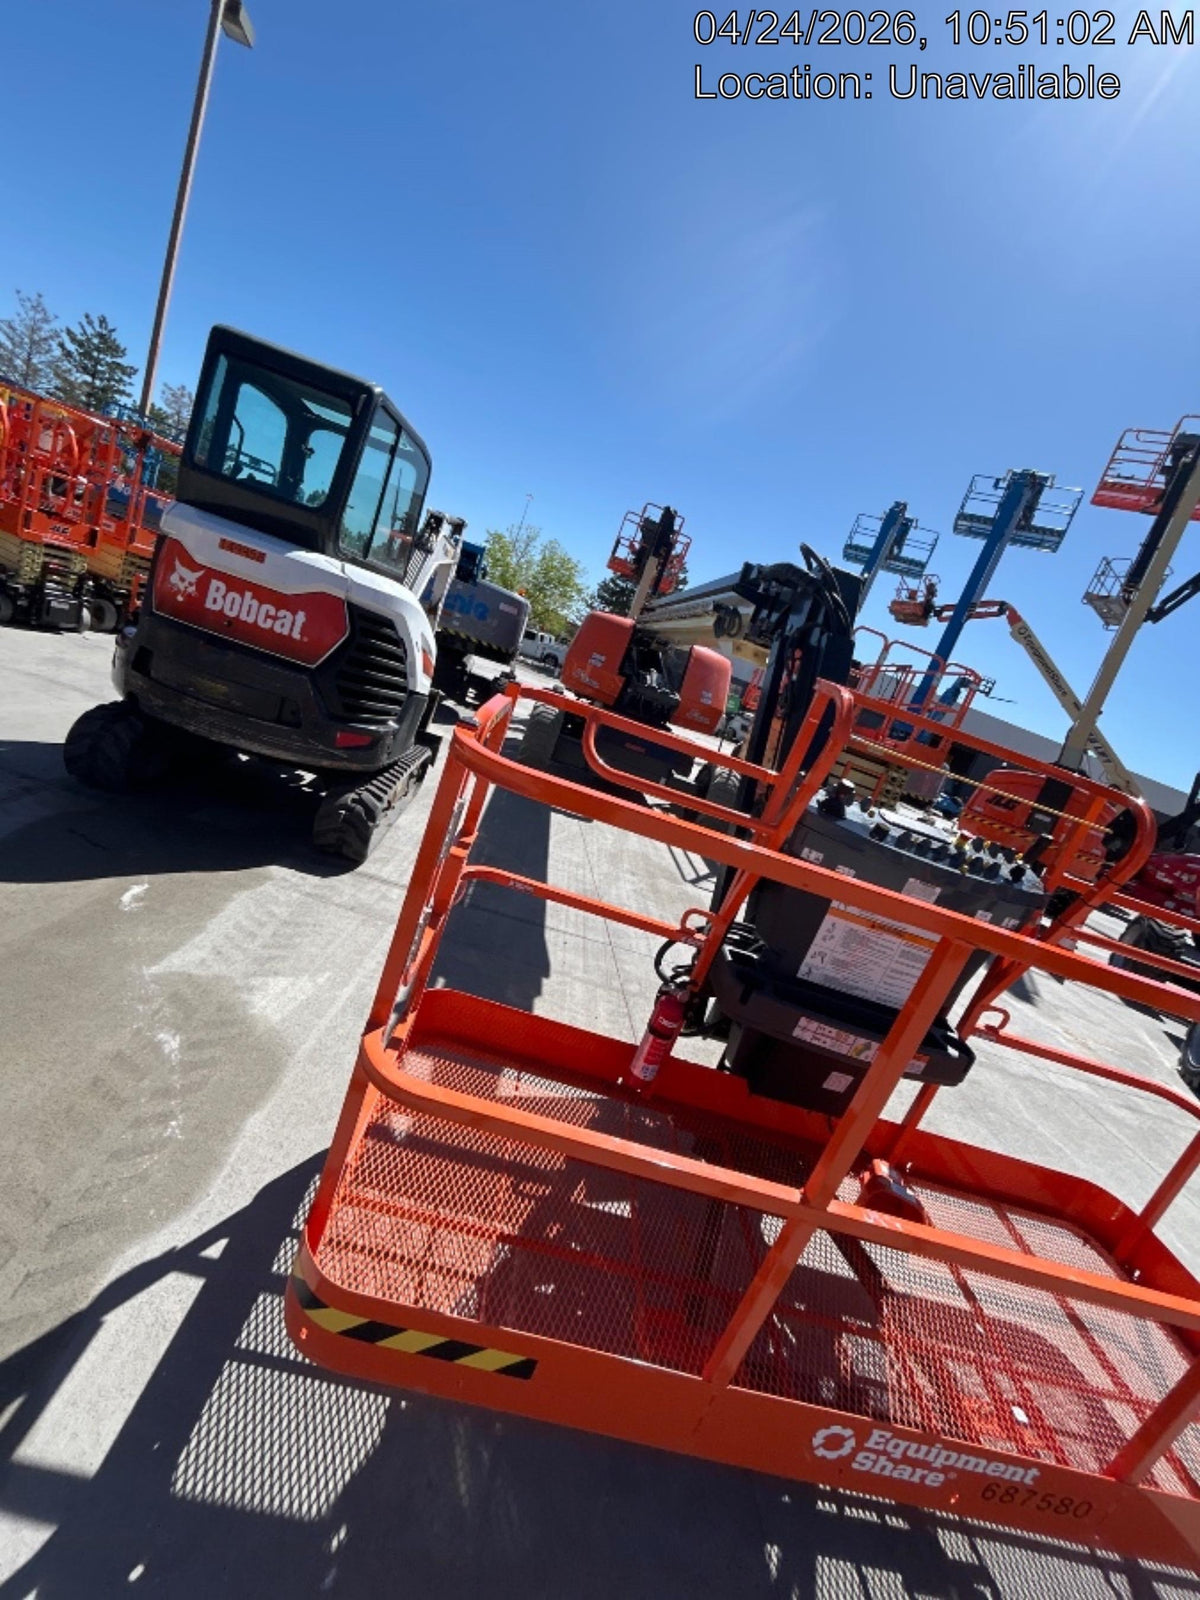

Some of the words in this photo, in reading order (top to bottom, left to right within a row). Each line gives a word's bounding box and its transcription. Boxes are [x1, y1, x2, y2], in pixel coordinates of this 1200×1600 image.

[204, 577, 307, 641] Bobcat
[851, 1451, 947, 1488] Share
[864, 1428, 1041, 1486] Equipment
[980, 1482, 1093, 1520] 687580
